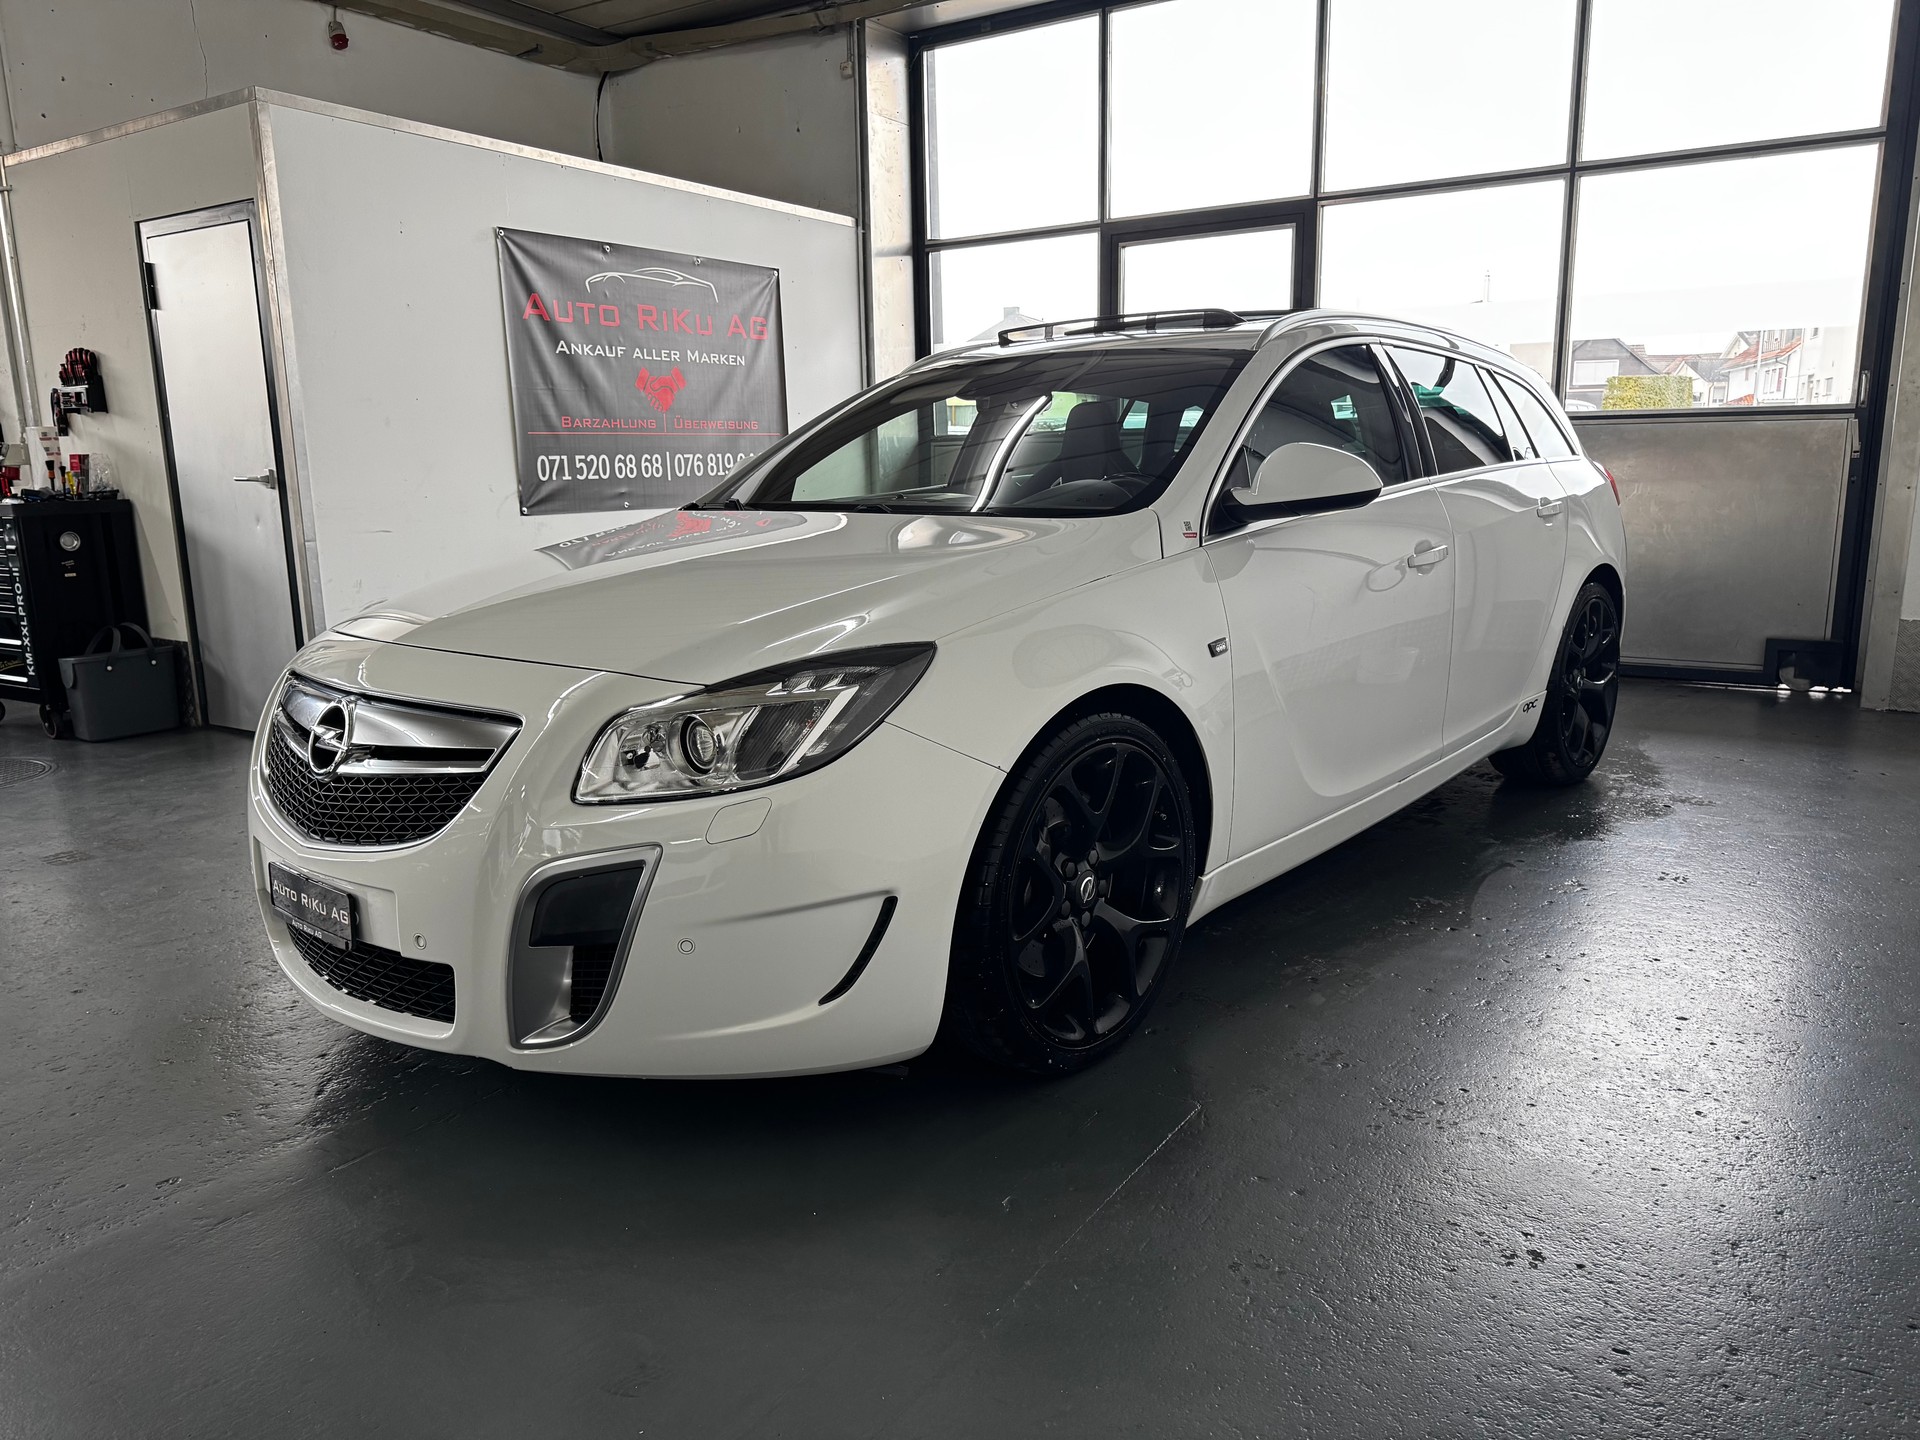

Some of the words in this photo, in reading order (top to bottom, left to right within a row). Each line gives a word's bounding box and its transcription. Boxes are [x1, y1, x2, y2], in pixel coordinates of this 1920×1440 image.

[523, 293, 621, 327] AUTO
[727, 313, 769, 340] AG
[555, 340, 627, 358] ANKAUF
[632, 347, 681, 362] ALLER
[686, 349, 746, 366] MARKEN
[561, 416, 657, 429] BARZAHLUNG
[674, 415, 760, 430] ÜBERWEISUNG
[536, 454, 572, 481] 071
[575, 454, 610, 480] 520
[614, 454, 637, 479] 68
[641, 454, 663, 478] 68
[674, 453, 704, 477] 076
[273, 880, 298, 902] AUTO
[331, 907, 350, 925] AG
[314, 930, 323, 939] AG
